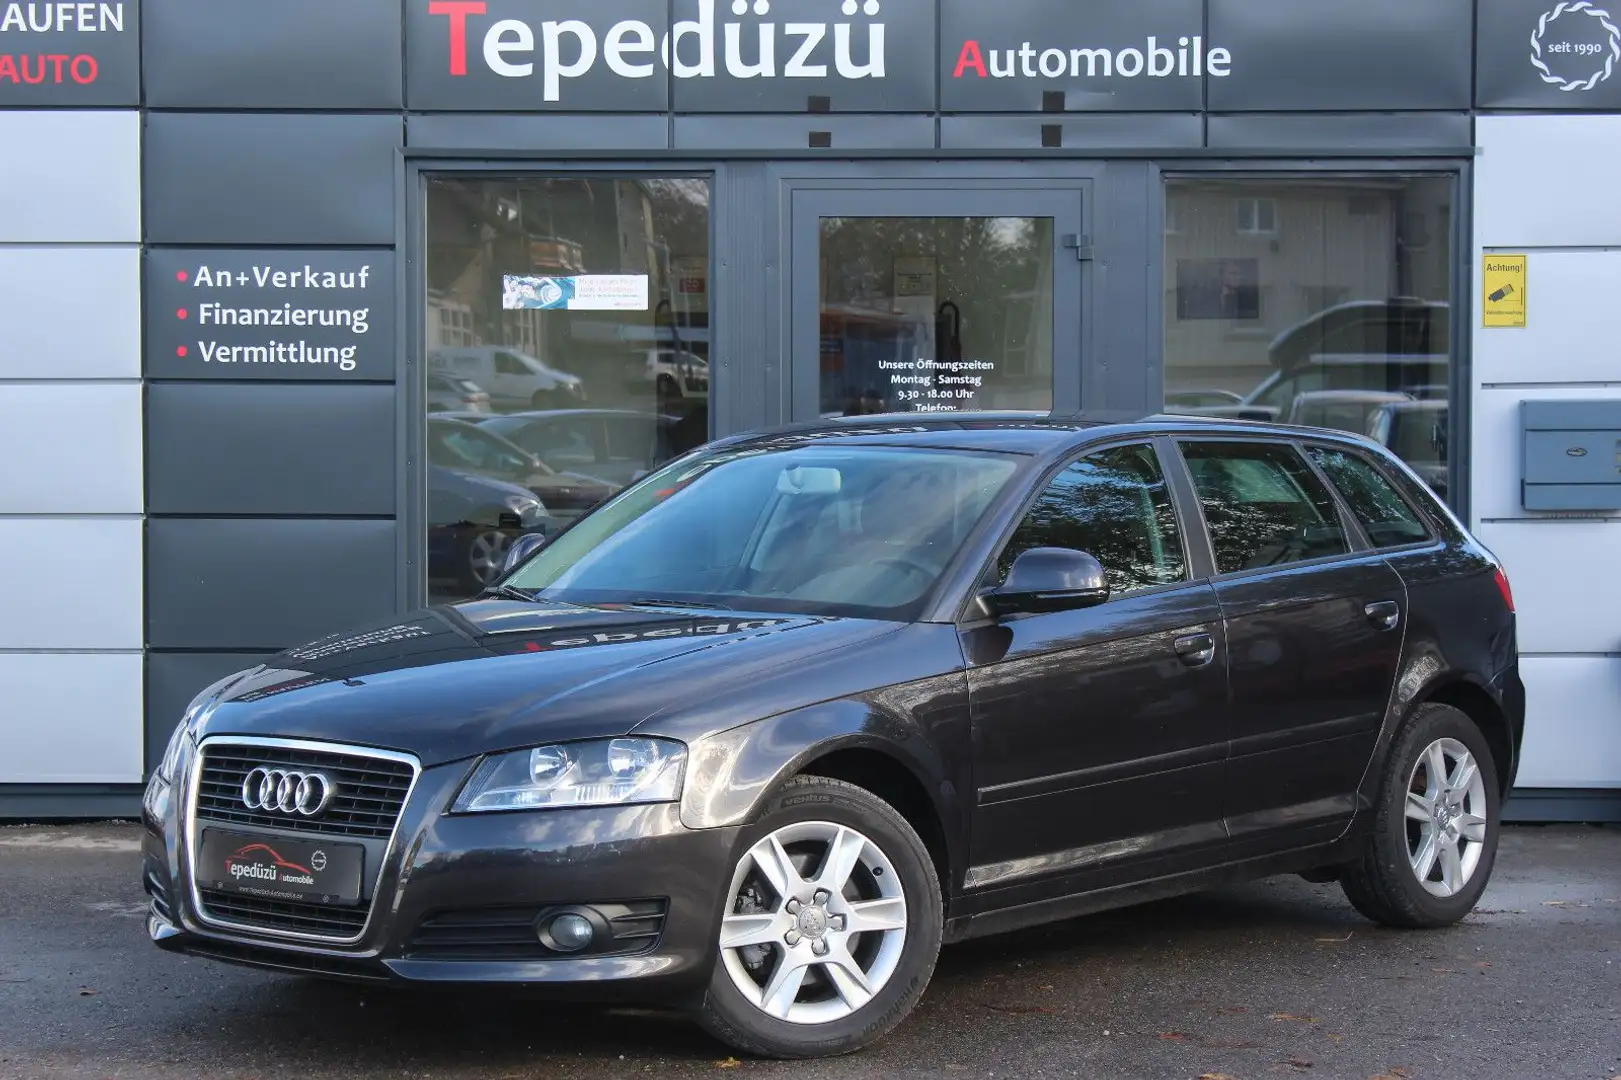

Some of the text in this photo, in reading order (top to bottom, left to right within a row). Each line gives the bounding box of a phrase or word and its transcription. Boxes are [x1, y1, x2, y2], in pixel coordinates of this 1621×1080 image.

[0, 3, 124, 33] AUFEN
[429, 0, 1233, 102] Tepedüzü Automobile
[1548, 42, 1602, 56] seit 1990
[0, 54, 99, 85] AUTO
[193, 266, 370, 289] An+Verkauf
[1486, 264, 1523, 273] Achtung!
[199, 303, 370, 333] Finanzierung
[199, 341, 357, 371] Vermittlung
[878, 358, 995, 372] Unsere Öffnungszeiten
[890, 375, 931, 386] Montag
[938, 375, 982, 386] Samstag
[898, 390, 919, 401] 9.30
[927, 389, 953, 399] 18.00
[955, 389, 975, 399] Uhr
[225, 859, 277, 881] Tepedüzü
